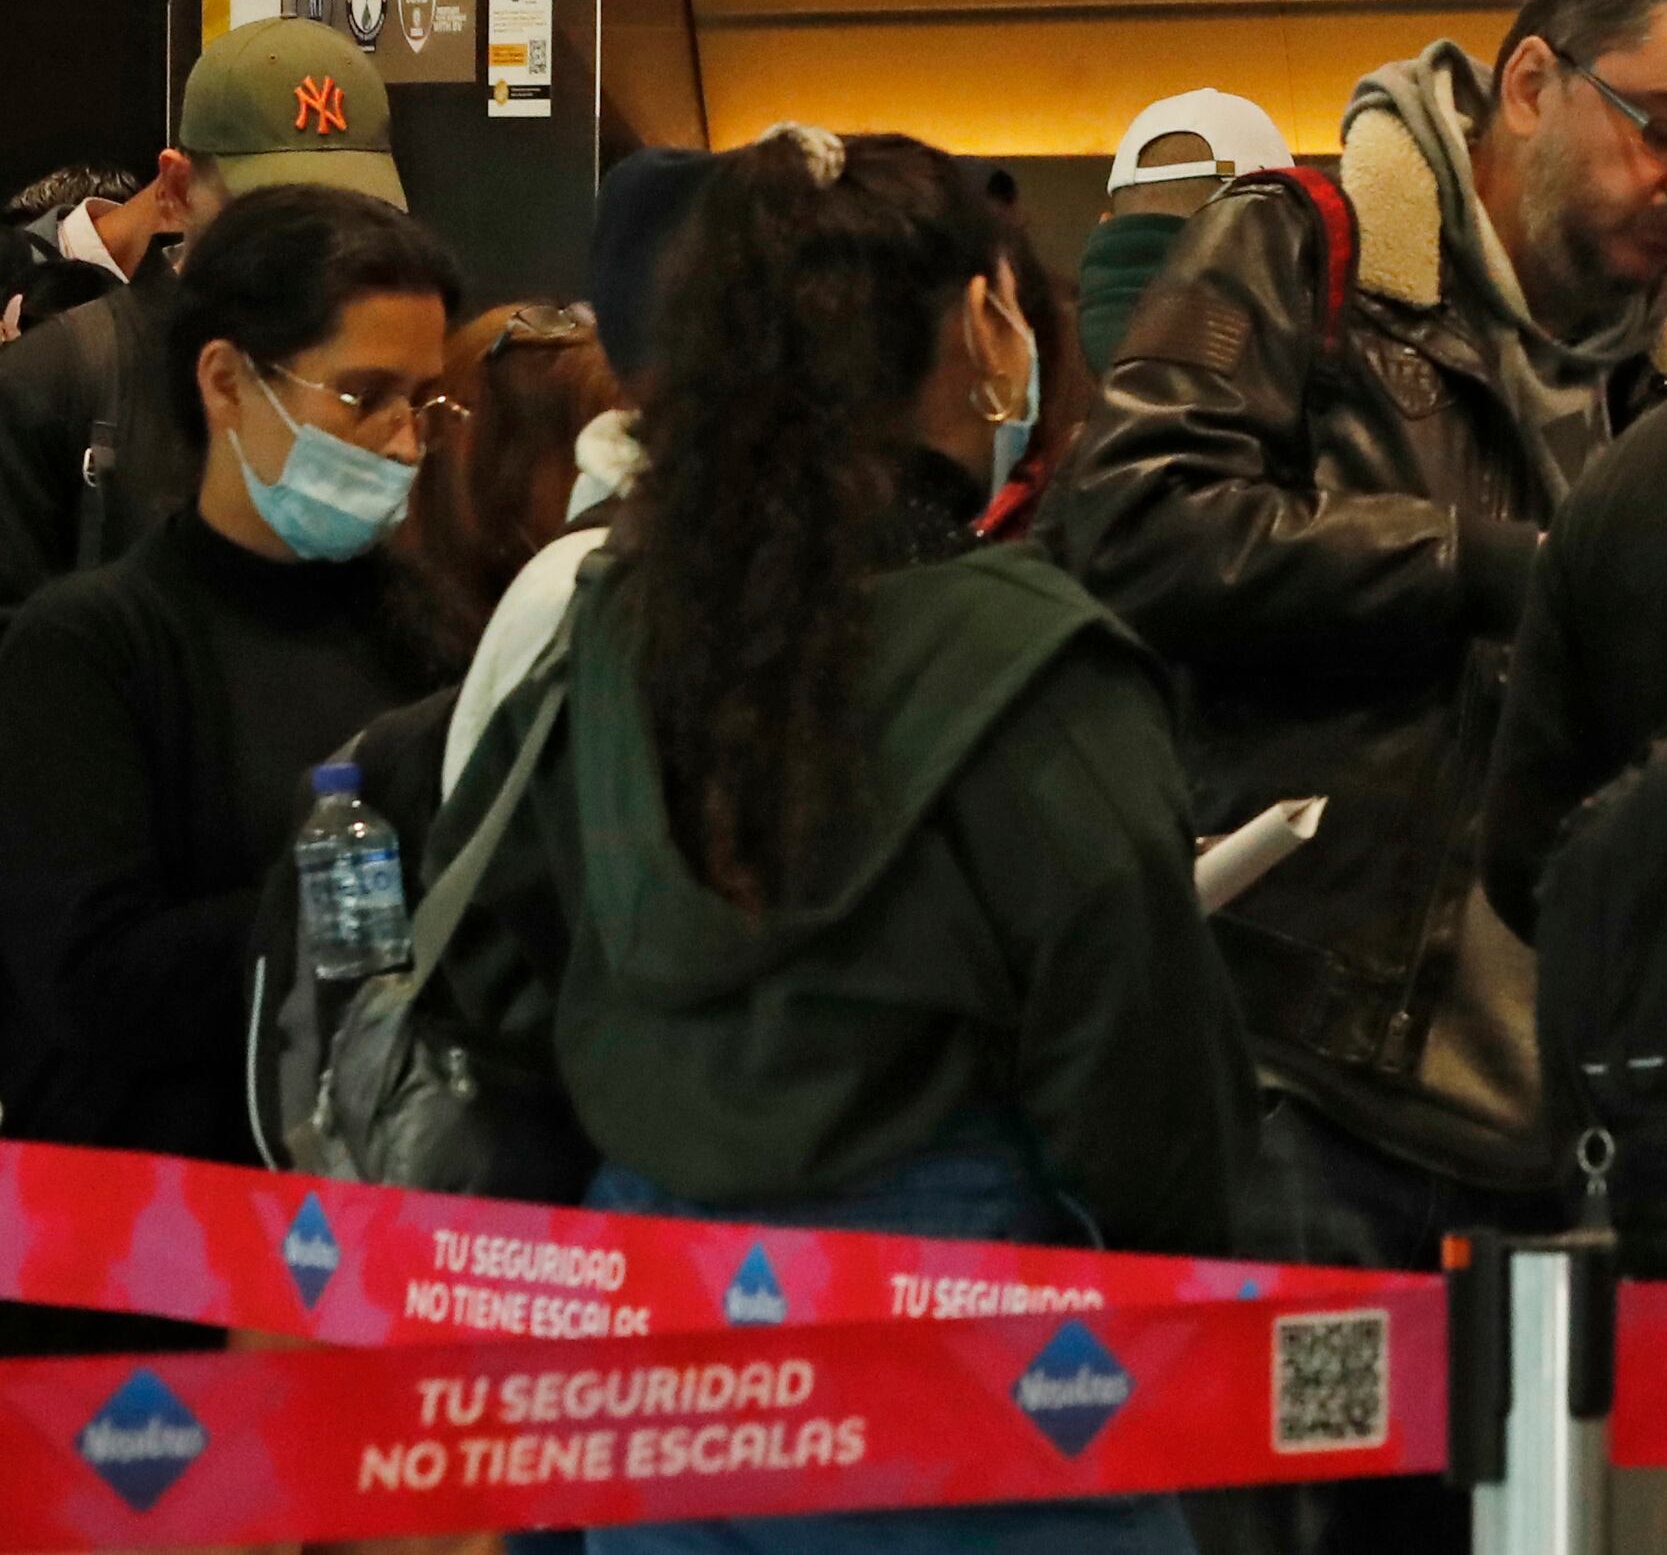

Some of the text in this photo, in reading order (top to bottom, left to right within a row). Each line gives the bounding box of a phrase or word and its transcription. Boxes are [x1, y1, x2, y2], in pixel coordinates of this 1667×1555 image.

[433, 1230, 625, 1291] TU SEGURIDAD
[421, 1361, 814, 1423] TU SEGURIDAD
[362, 1418, 864, 1487] NO TIENE ESCALAS
